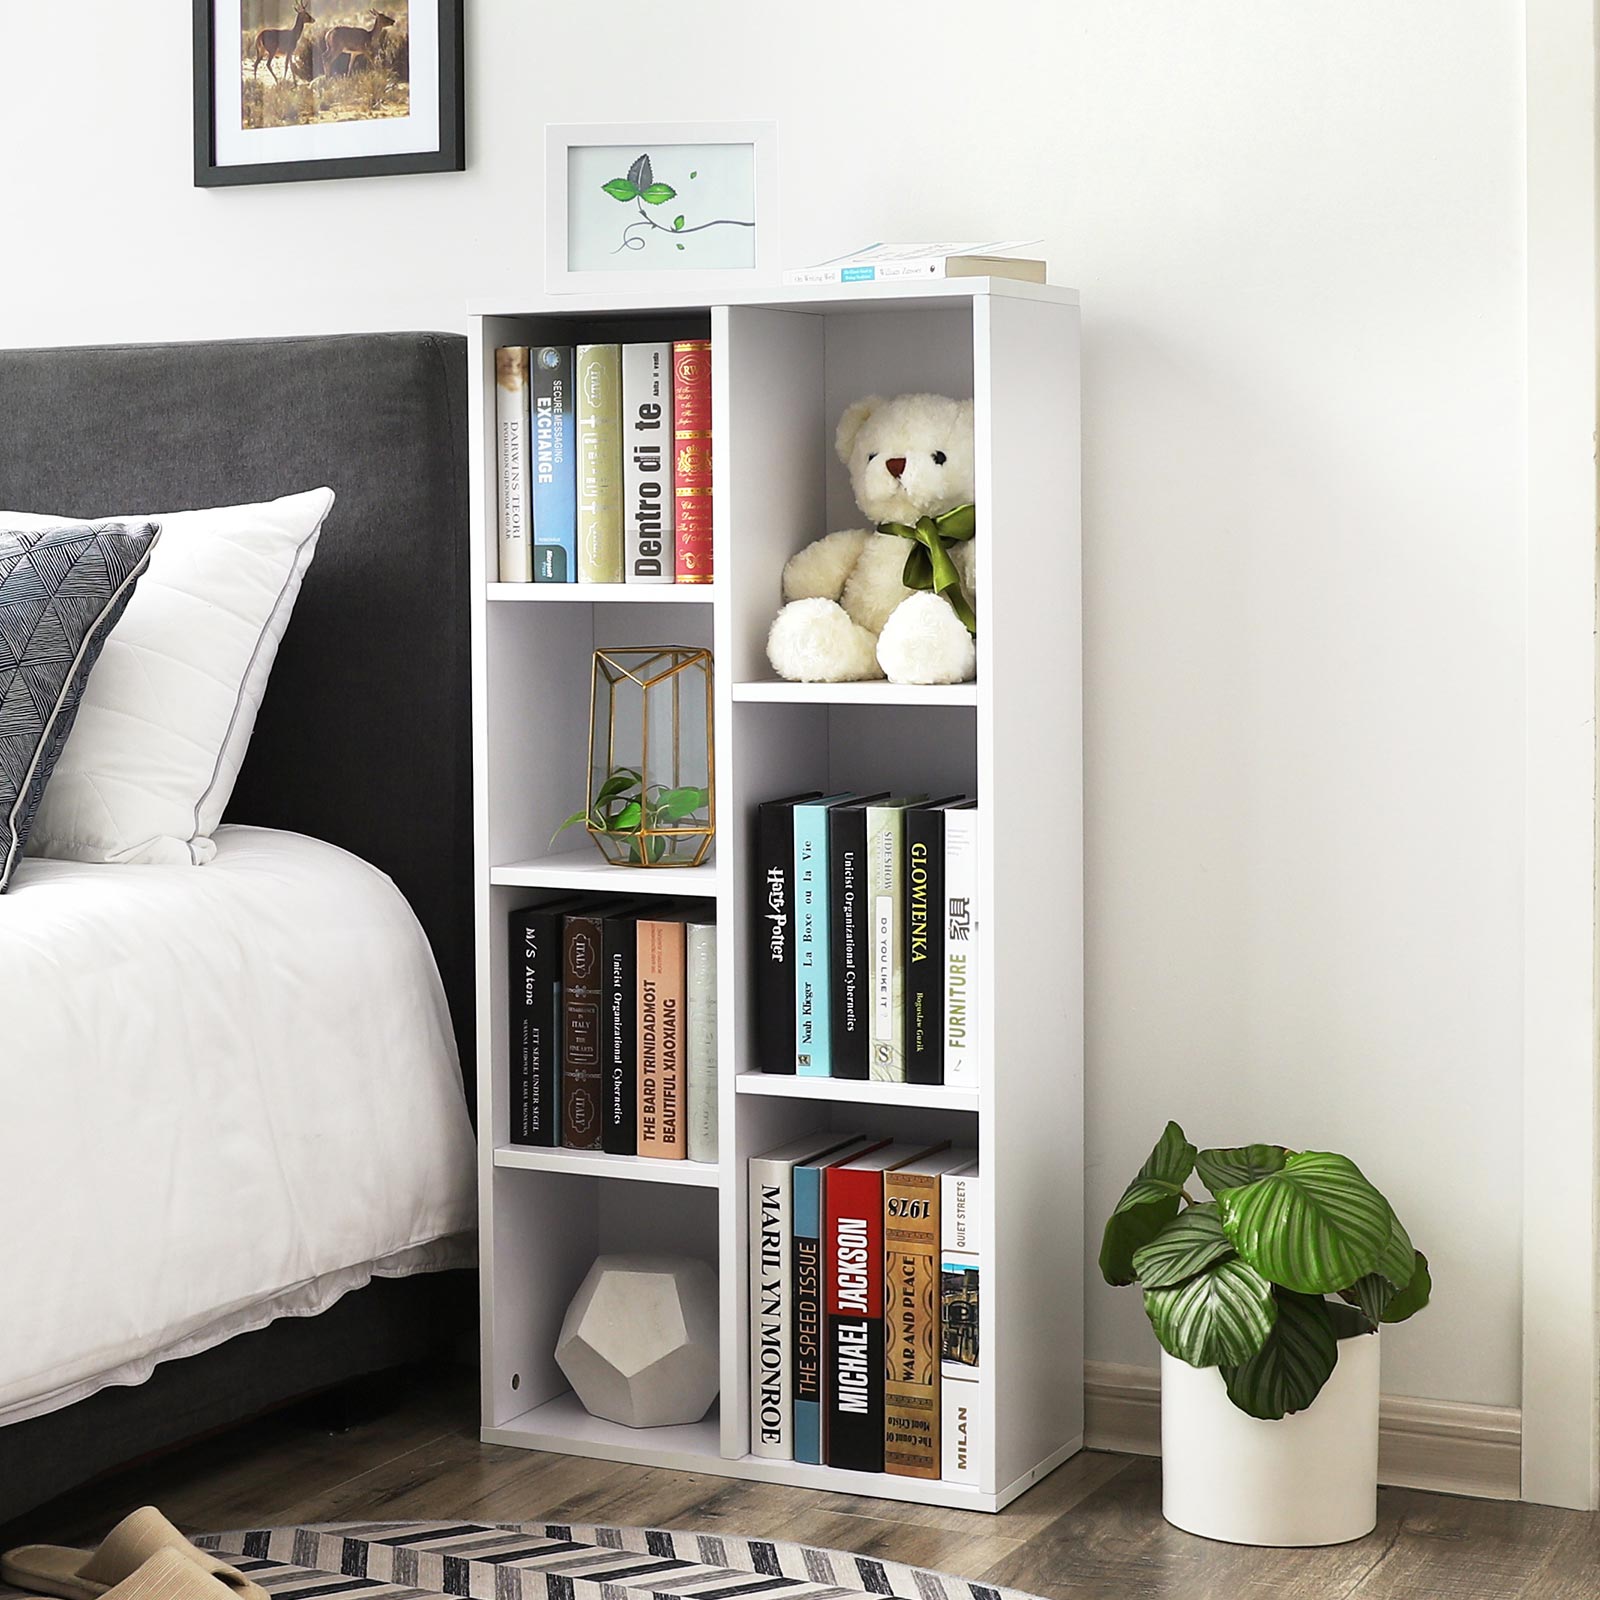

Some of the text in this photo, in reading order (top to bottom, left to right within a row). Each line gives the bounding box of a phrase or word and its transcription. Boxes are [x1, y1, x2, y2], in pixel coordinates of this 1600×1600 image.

[537, 397, 553, 484] EXCHANGE
[552, 380, 563, 463] SECURE MESSAGING
[510, 422, 520, 539] DARWINS TEORI
[633, 403, 662, 577] Dentro di te
[803, 840, 812, 861] Vie
[803, 870, 812, 881] la
[883, 831, 892, 889] SIDESHOW
[764, 866, 787, 963] Harry Potter
[803, 913, 812, 943] Boxe
[804, 890, 812, 905] ou
[880, 918, 887, 934] DO
[911, 843, 927, 963] GLOWIENKA
[949, 897, 969, 941] 家具
[525, 927, 538, 1006] M/S Atene
[575, 942, 586, 971] ITALY
[803, 951, 812, 967] La
[843, 852, 856, 1032] Unicist Organizational Cybernetics
[571, 1020, 591, 1029] ITALY
[880, 996, 887, 1008] IT
[949, 954, 966, 1048] FURNITURE
[532, 1047, 540, 1072] SEKEL
[612, 953, 623, 1125] Unicist Organizational Cybernetics
[643, 980, 656, 1141] THE BARD TRINIDADMOST
[802, 1023, 812, 1044] Noah
[532, 1074, 540, 1104] UNDER
[663, 999, 676, 1144] BEAUTIFUL XIAOXIANG
[575, 1097, 585, 1126] ITALY
[887, 1196, 931, 1220] 1978
[956, 1180, 966, 1247] QUIET STREETS
[799, 1242, 817, 1394] THE SPEED ISSUE
[837, 1217, 868, 1414] MICHAEL JACKSON
[902, 1255, 916, 1382] WAR AND PEACE
[761, 1321, 782, 1446] MONROE
[886, 1431, 932, 1448] The Count Of
[887, 1416, 911, 1429] Cristo
[958, 1406, 967, 1470] MILAN
